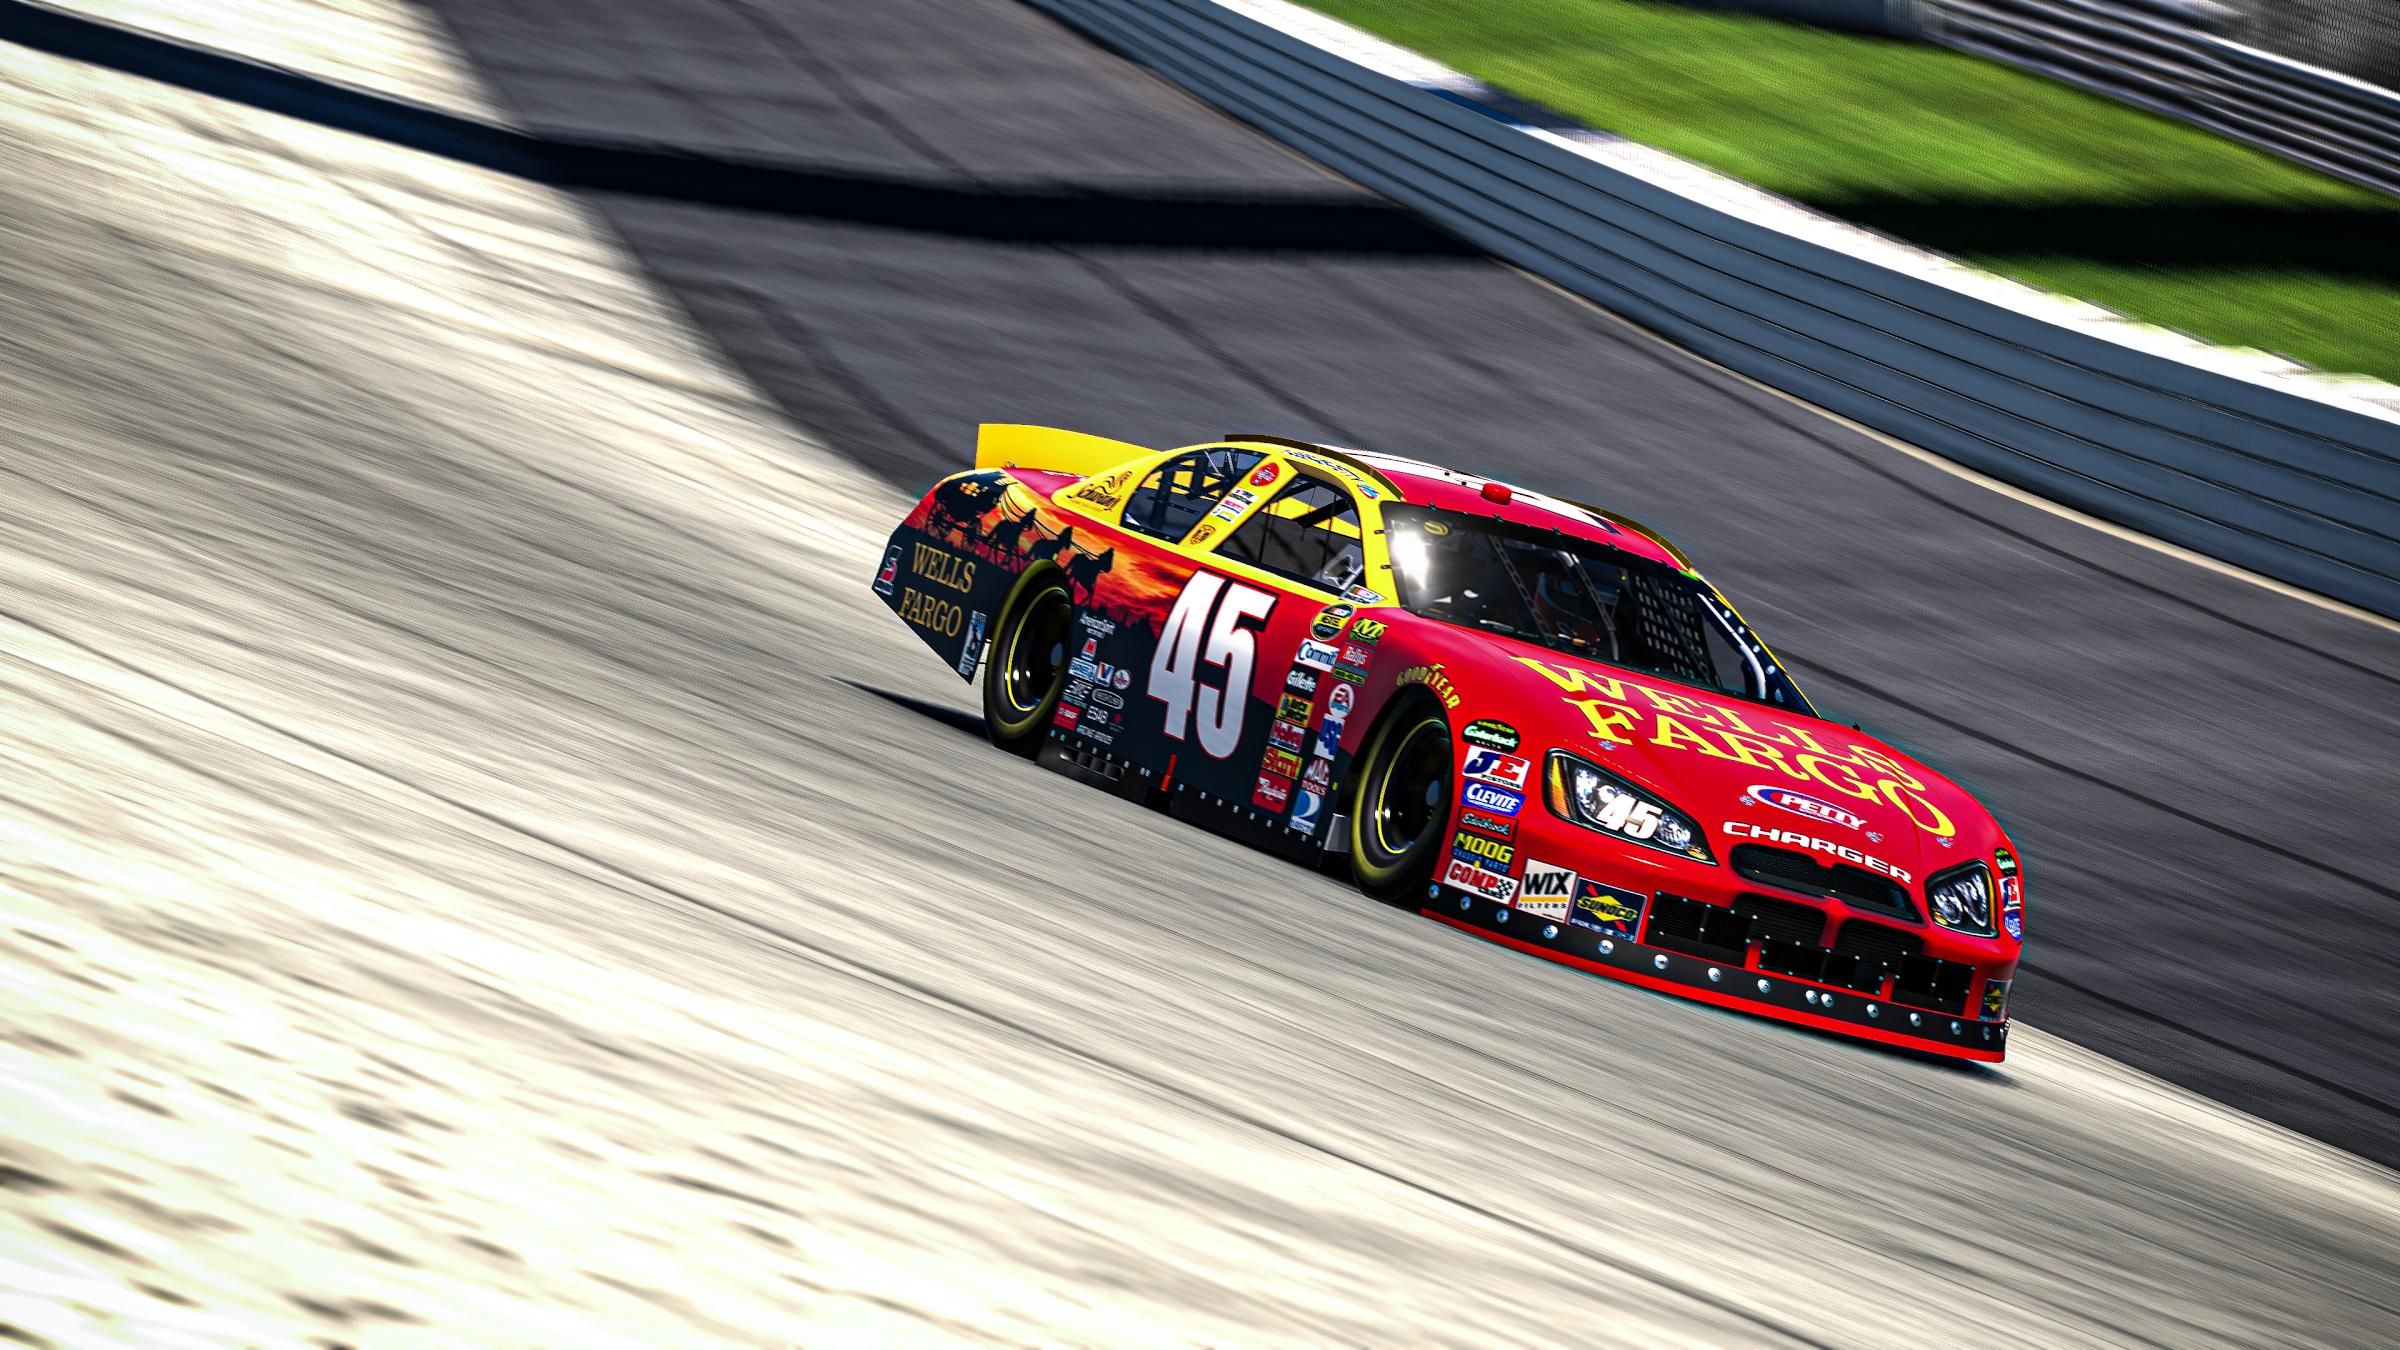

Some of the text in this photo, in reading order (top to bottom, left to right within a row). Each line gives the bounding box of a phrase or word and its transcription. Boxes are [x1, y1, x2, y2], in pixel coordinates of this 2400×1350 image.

[912, 542, 977, 593] WELLS
[897, 586, 964, 637] FARGO
[1147, 568, 1279, 760] 45
[1297, 641, 1339, 666] Commit
[1286, 670, 1316, 692] Gillette
[1396, 663, 1460, 709] GOODYEAR
[1508, 655, 1926, 791] WELLS
[1464, 751, 1525, 782] JE
[1562, 696, 1955, 837] FARGO
[1466, 783, 1520, 811] CLEVITE
[1780, 793, 1868, 830] PETTY
[1595, 794, 1664, 840] 45
[1453, 832, 1515, 864] MOOG
[1723, 821, 1912, 884] CHARGER
[1449, 863, 1499, 891] COMP
[1524, 871, 1573, 895] WIX
[1517, 902, 1567, 910] FILTERS
[1581, 897, 1635, 919] SUNOCO
